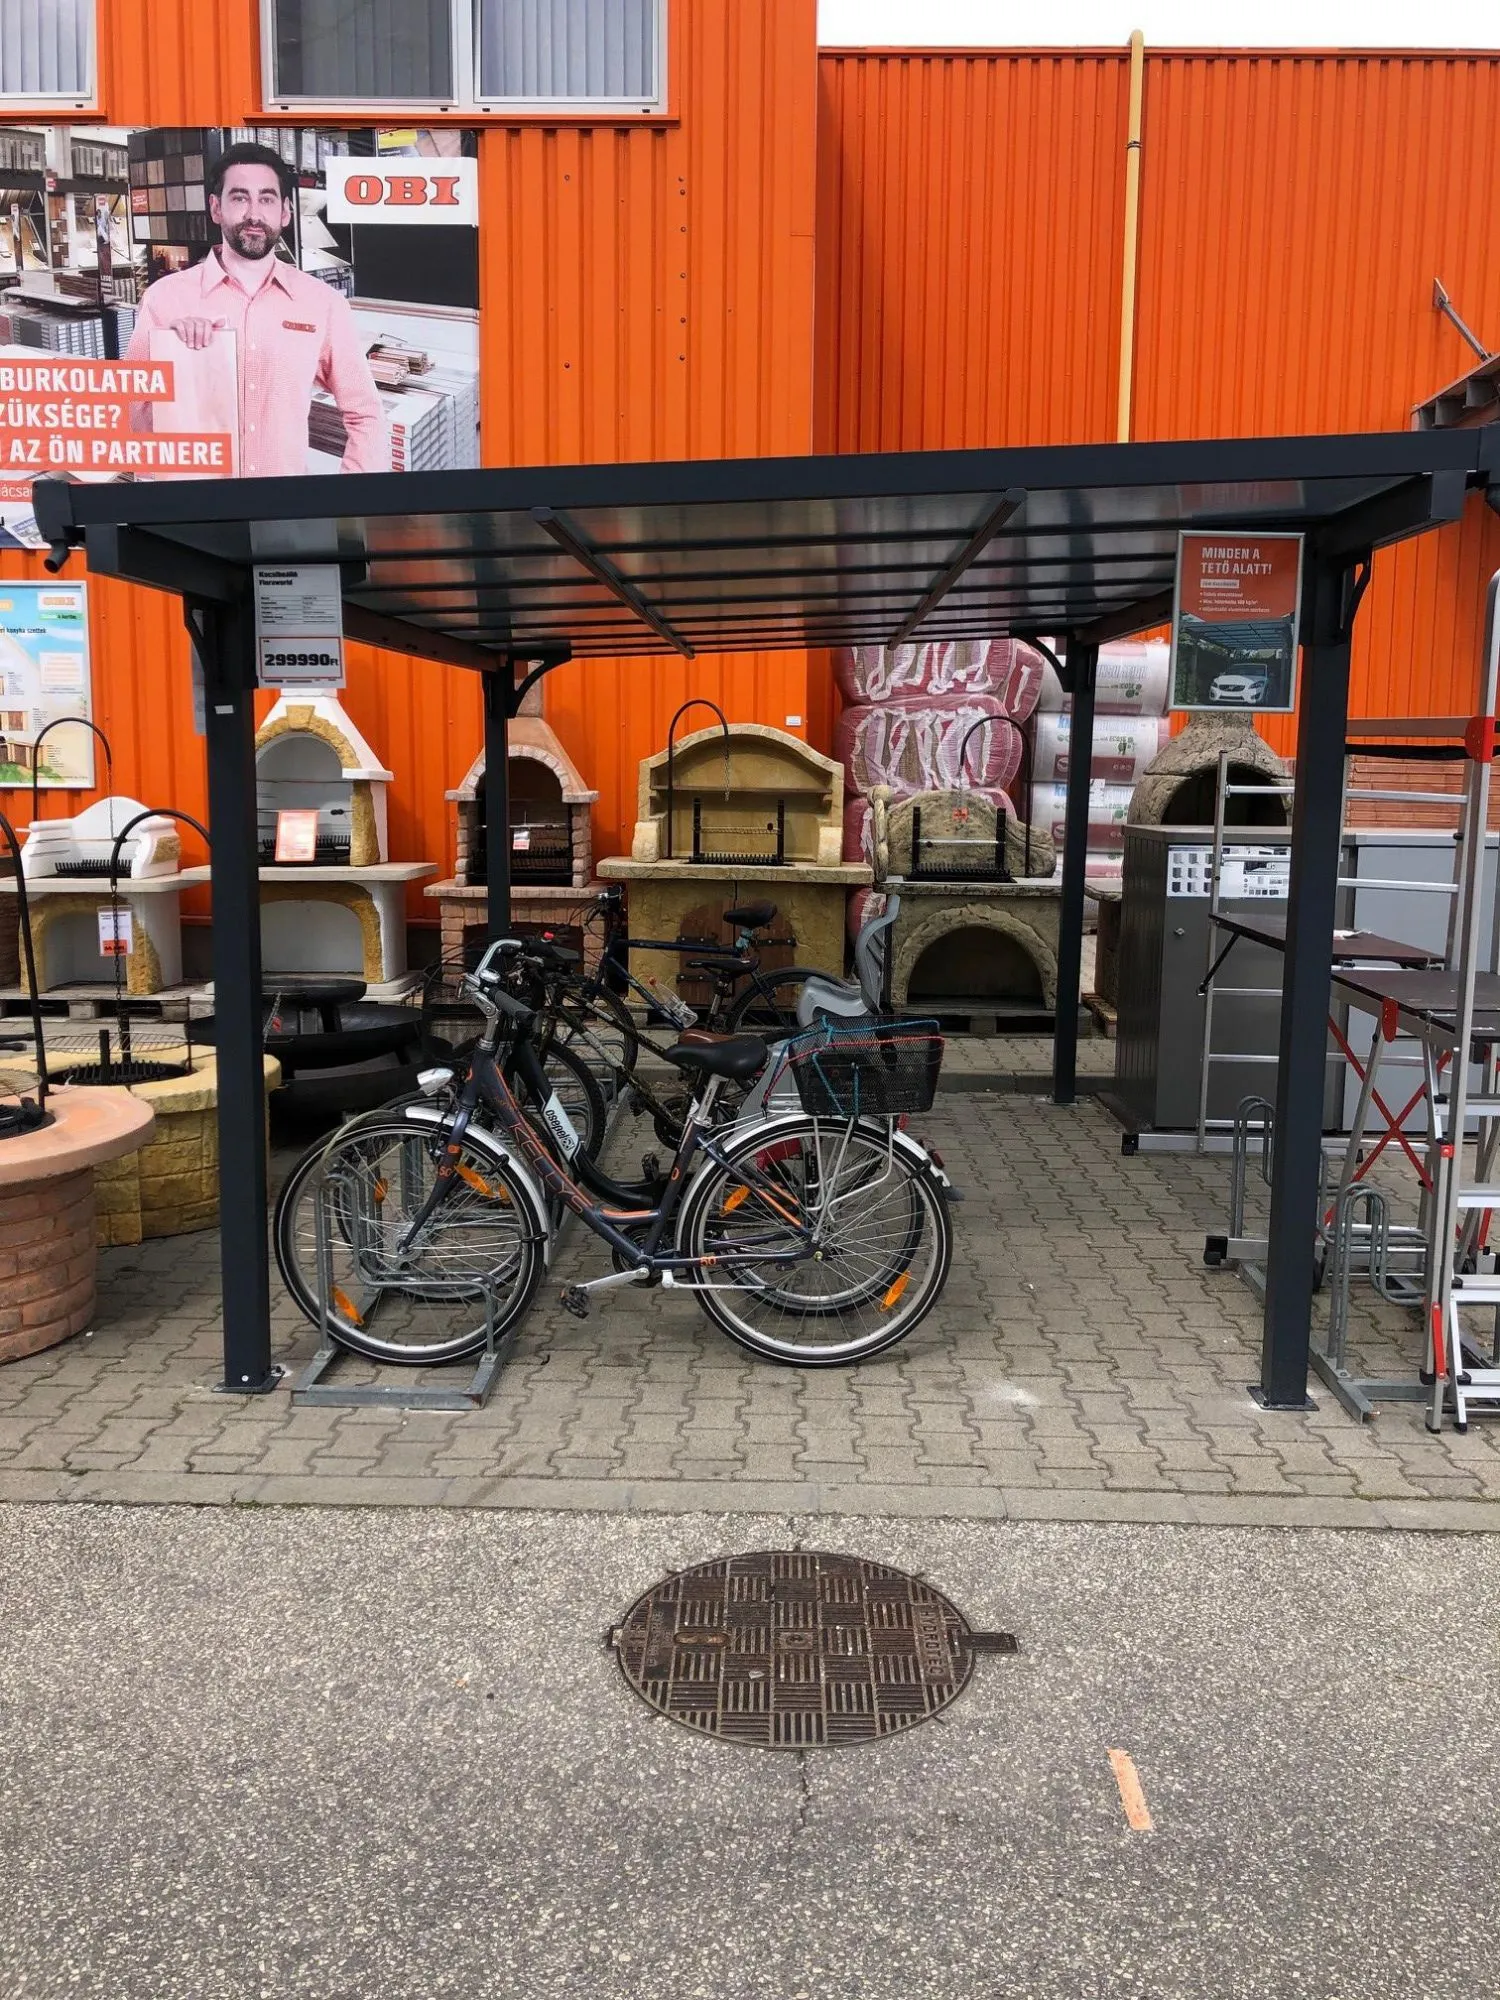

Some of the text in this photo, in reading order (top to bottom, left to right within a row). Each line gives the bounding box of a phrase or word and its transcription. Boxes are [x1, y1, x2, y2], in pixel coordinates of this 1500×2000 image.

[344, 175, 460, 205] OBI
[0, 367, 167, 394] BURKOLATRA
[9, 435, 223, 465] AZ ÖN PARTNERE
[1202, 547, 1260, 560] MINDEN A
[1233, 562, 1272, 575] ALATT!
[545, 1109, 571, 1142] csepel
[508, 1122, 584, 1214] KELLYS
[919, 1610, 945, 1676] HYDROTEC
